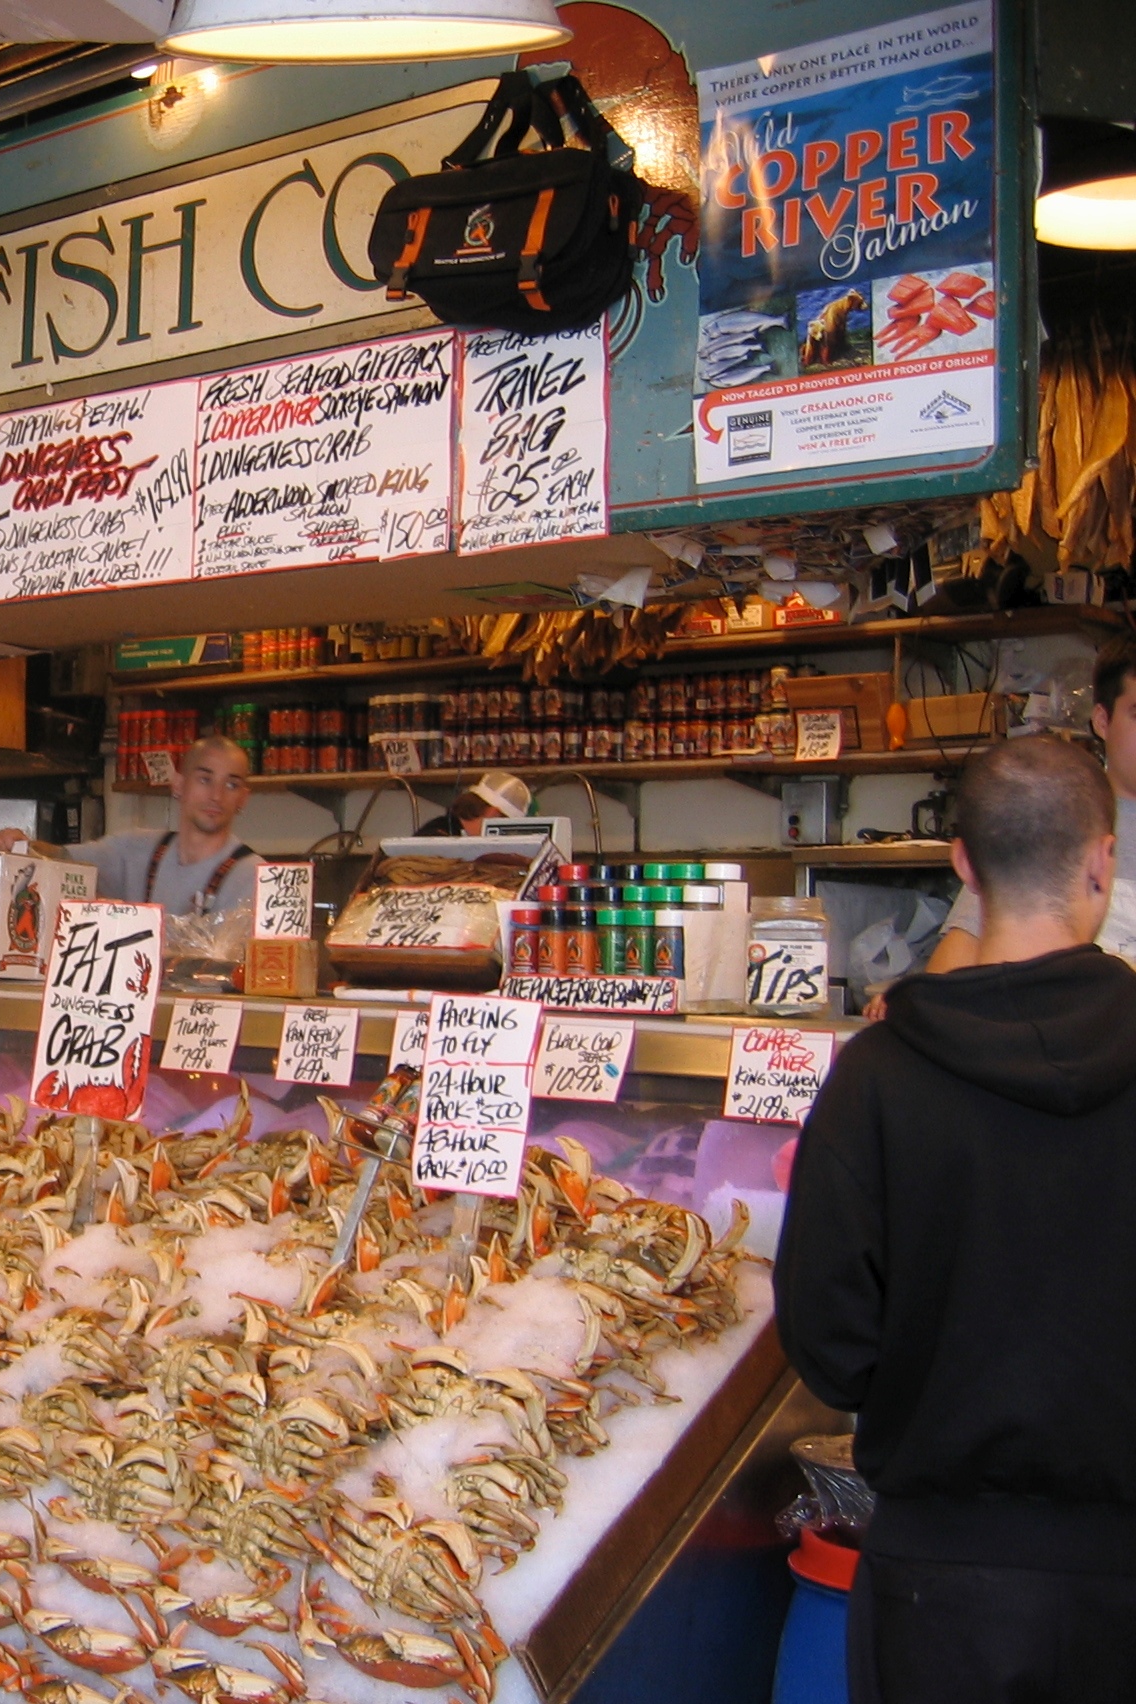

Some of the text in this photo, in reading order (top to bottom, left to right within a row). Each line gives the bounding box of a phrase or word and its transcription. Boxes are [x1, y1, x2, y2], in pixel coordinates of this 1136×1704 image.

[709, 16, 980, 94] THERE'S ONLY ONE PLACE IN THE WORLD
[714, 88, 758, 108] WHERE
[761, 76, 812, 96] COPPER
[814, 72, 826, 84] IS
[829, 59, 876, 81] BETTER
[879, 48, 921, 67] THAN
[715, 110, 976, 209] COPPER
[741, 172, 943, 258] RIVER
[820, 199, 979, 281] Salmon
[199, 356, 353, 411] FRESH SEAFOOD
[472, 351, 586, 417] TRAVEL
[721, 354, 990, 403] NOW TAGGED TO PROVIDE YOU WITH PROOF OF ORIGIN!
[210, 403, 272, 442] COPPER
[269, 395, 322, 433] RIVER
[800, 392, 894, 415] CRSALMON.ORG
[849, 409, 861, 417] ON
[862, 405, 884, 416] YOUR
[480, 407, 566, 465] BAG
[795, 416, 879, 434] COPPER RIVER SALMON
[798, 441, 818, 451] WIN
[828, 437, 852, 448] FREE
[809, 429, 853, 440] EXPERIENCE
[208, 424, 373, 485] DUNGENESS CRAB
[12, 454, 160, 512] CRAB FEAST
[223, 463, 433, 523] ALDERWOOD SMOKED KING
[546, 467, 596, 505] EACH
[283, 498, 351, 522] SALMON
[4, 512, 80, 551] DUNGENESS
[61, 882, 88, 897] PLACE
[65, 872, 84, 884] PIKE
[51, 921, 155, 997] FAT
[748, 949, 825, 1006] TIPS
[50, 992, 135, 1023] DUNGENESS
[437, 999, 519, 1033] PACKING
[45, 1012, 127, 1068] CRAB
[431, 1032, 459, 1056] TO
[460, 1031, 498, 1057] FLY
[545, 1025, 623, 1052] BLACK COD
[742, 1028, 807, 1053] COPPER
[734, 1065, 825, 1089] KING SALMON
[766, 1050, 817, 1073] RIVER
